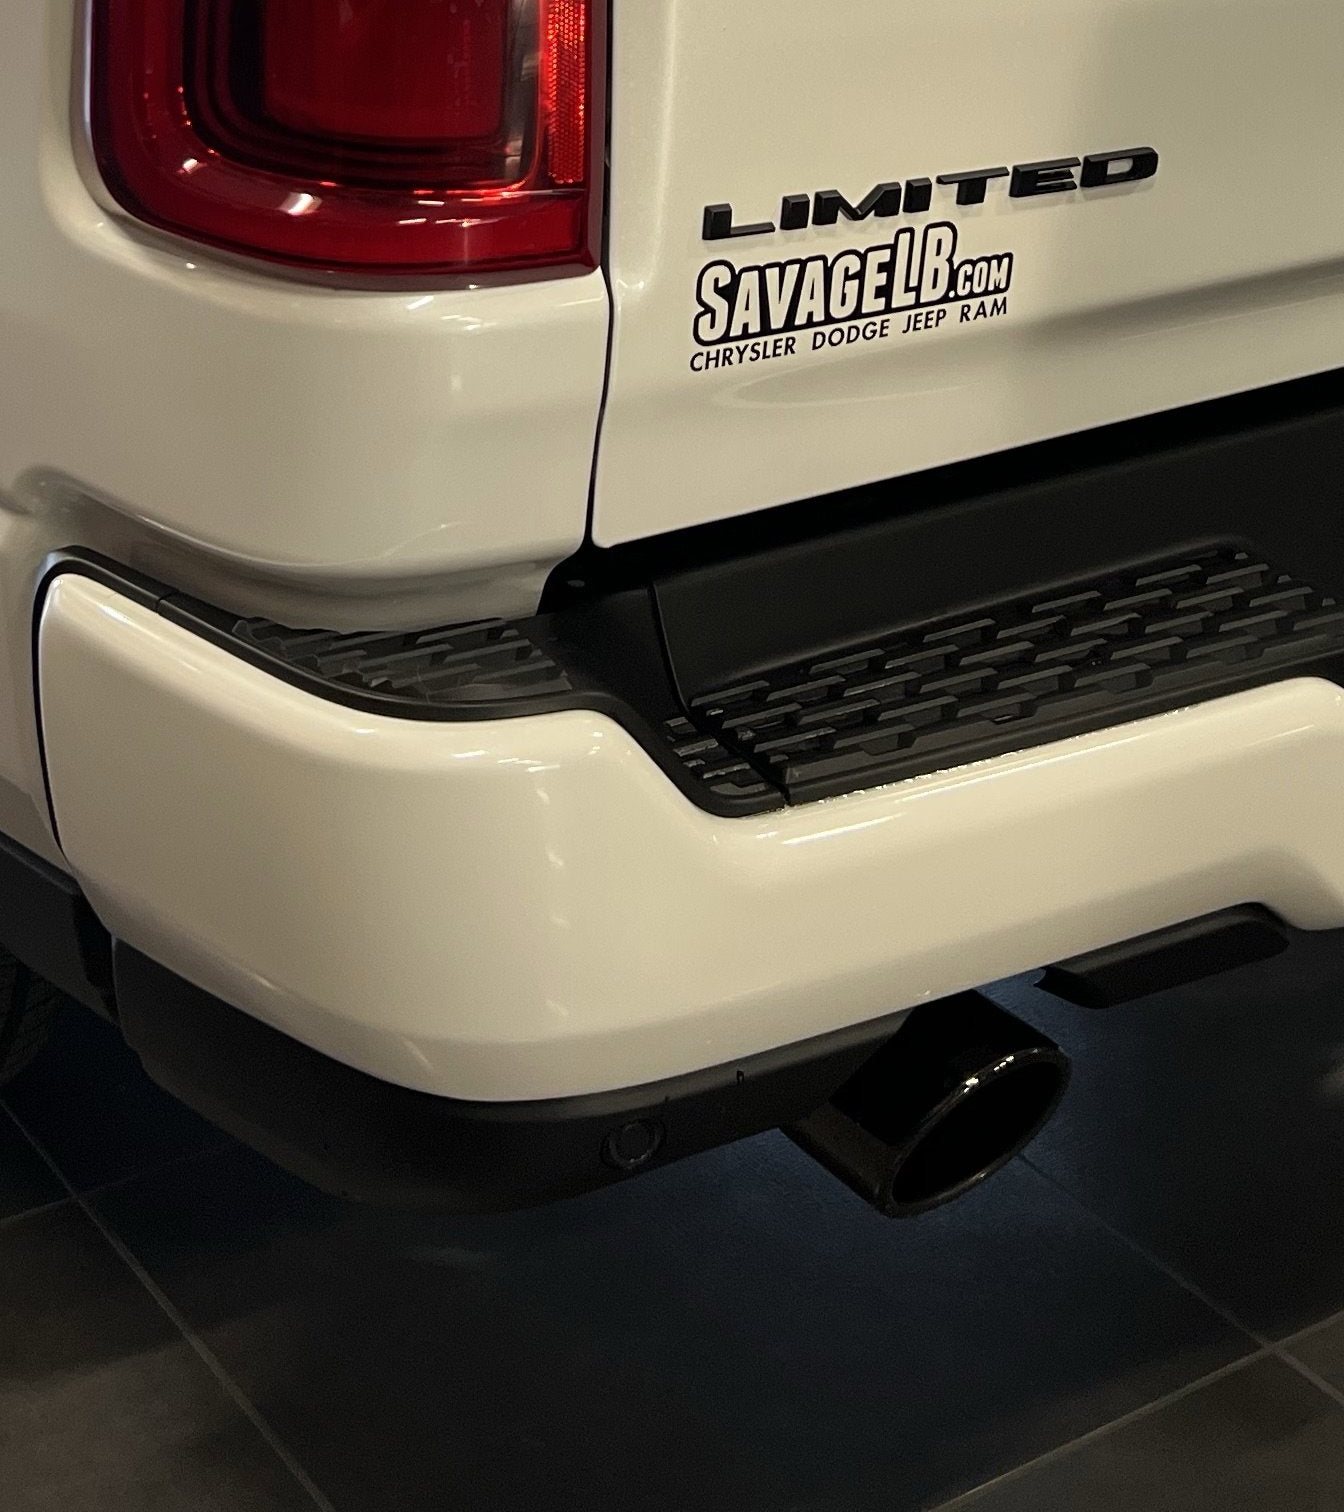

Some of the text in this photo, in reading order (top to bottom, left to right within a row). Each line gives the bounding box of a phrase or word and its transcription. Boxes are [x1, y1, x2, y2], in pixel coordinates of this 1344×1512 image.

[701, 146, 1159, 241] LIMITED
[689, 296, 1008, 372] CHRYSLER DODGE JEEP RAM
